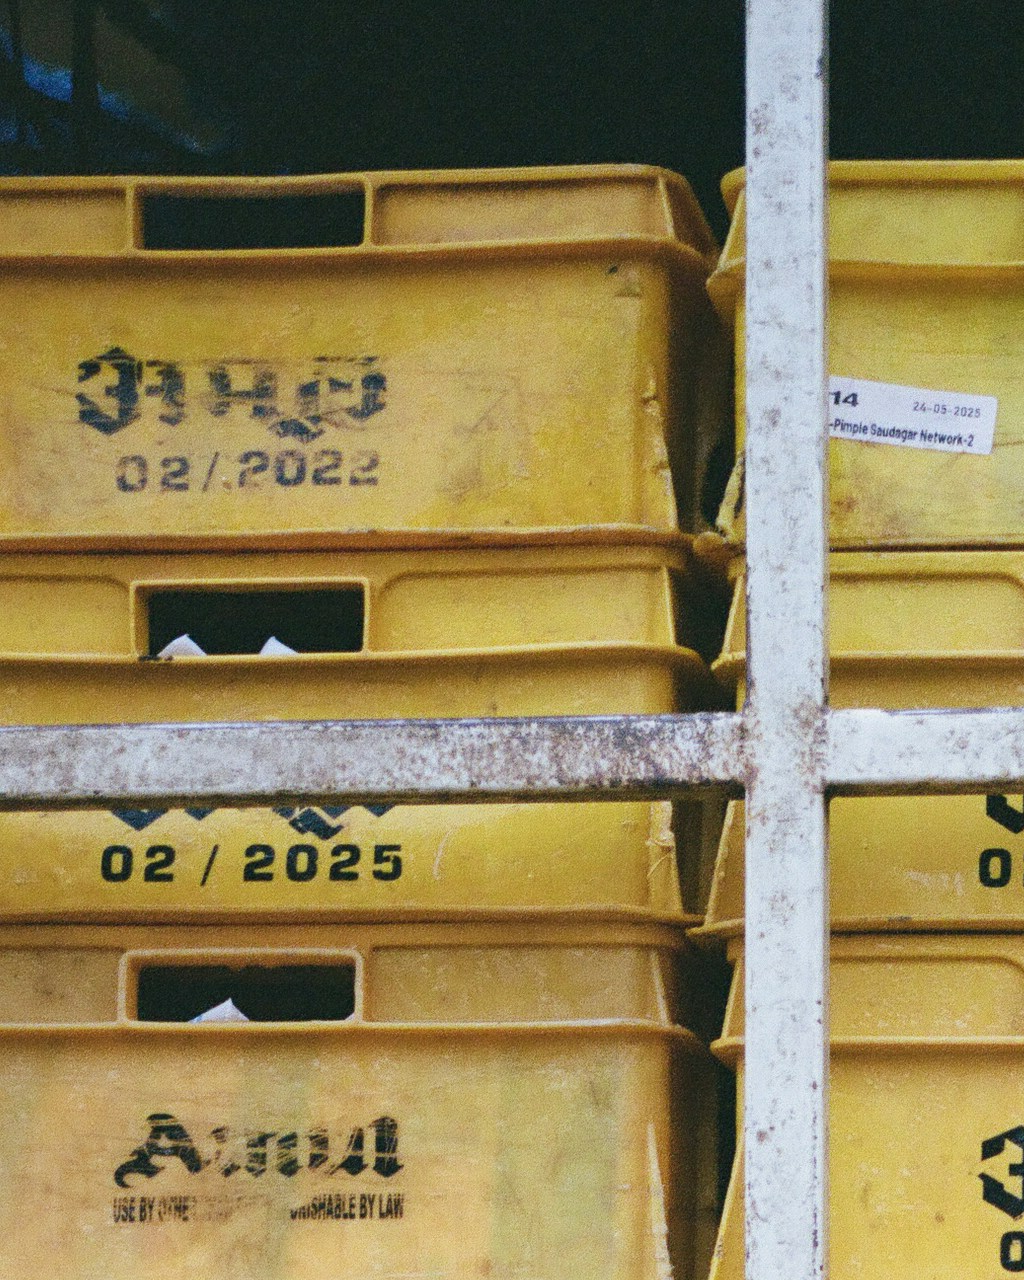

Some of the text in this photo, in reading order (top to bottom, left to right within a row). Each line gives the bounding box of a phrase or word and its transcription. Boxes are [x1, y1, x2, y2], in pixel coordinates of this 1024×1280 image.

[829, 390, 859, 407] 14
[912, 400, 981, 418] 24-05-2025
[870, 423, 918, 443] Saudagar
[359, 1194, 376, 1220] BY
[378, 1194, 404, 1220] LAW
